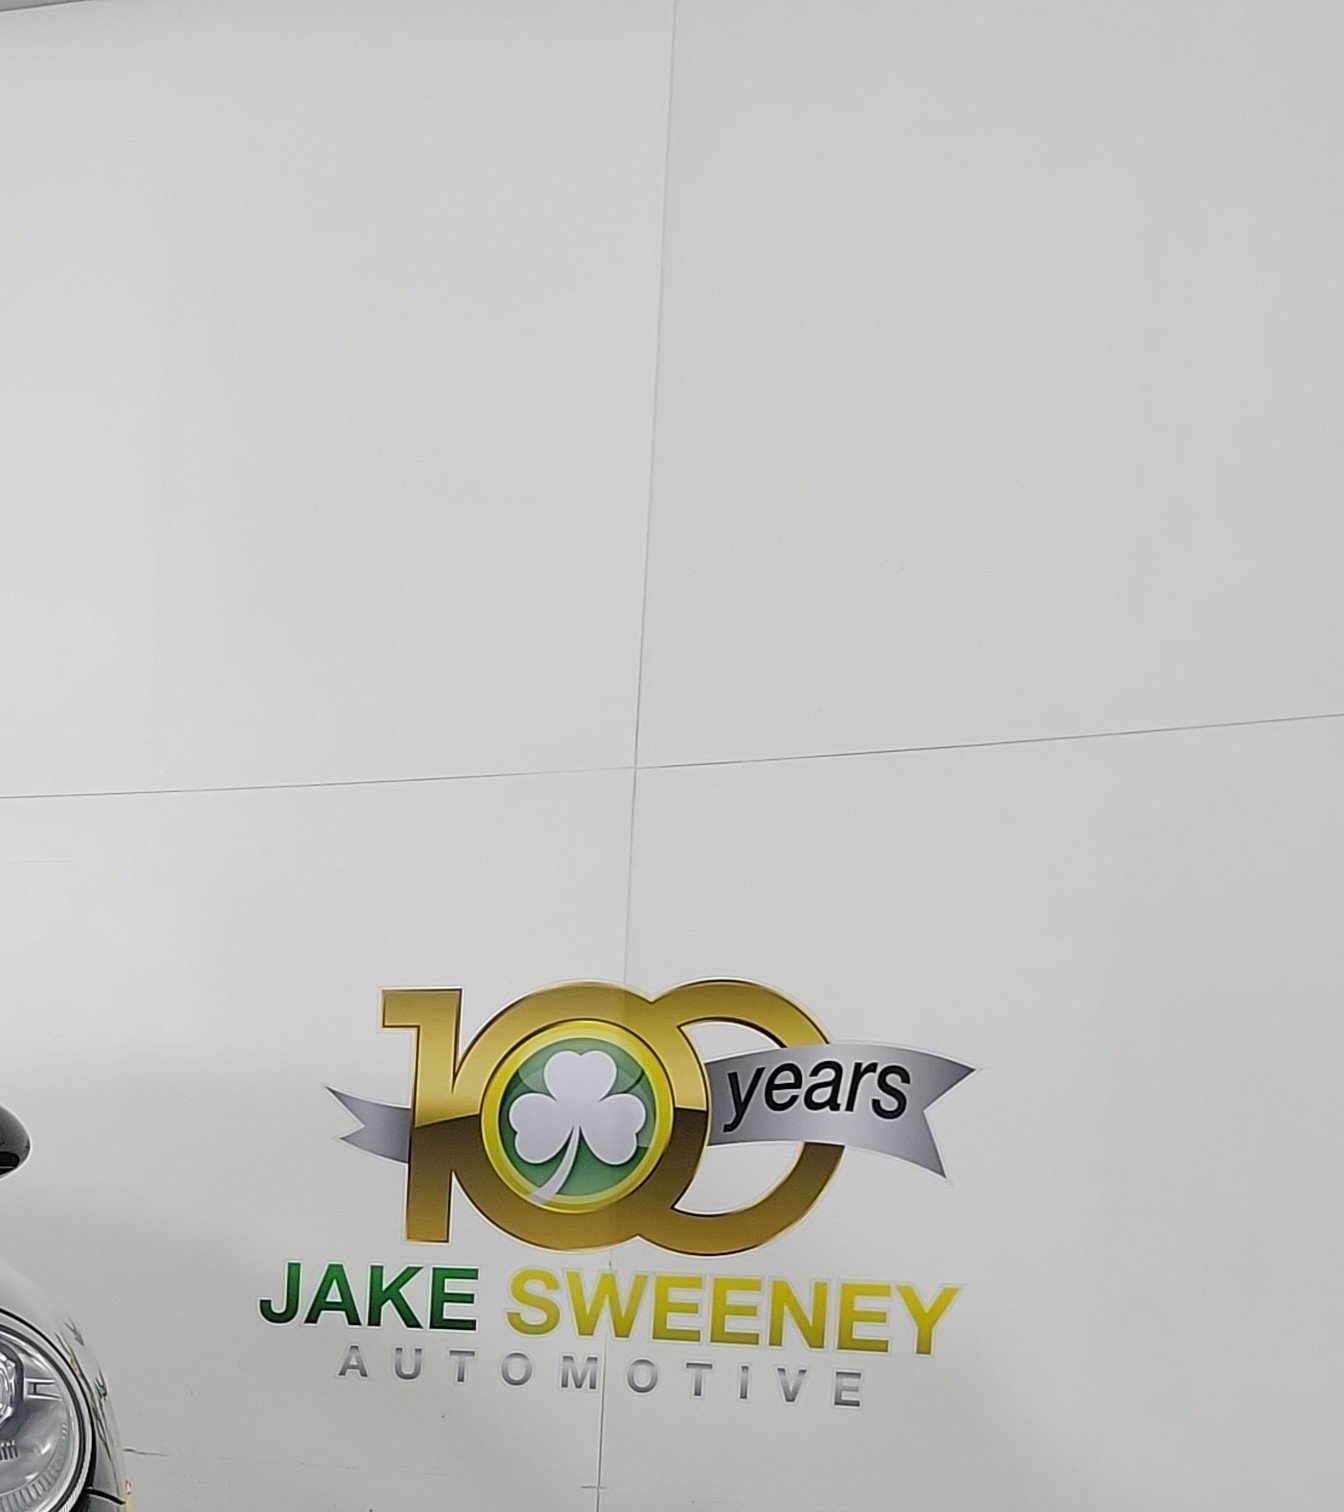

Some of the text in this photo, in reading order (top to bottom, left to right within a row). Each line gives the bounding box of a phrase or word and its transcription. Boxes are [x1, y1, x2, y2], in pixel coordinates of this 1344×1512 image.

[381, 979, 912, 1256] 100 years
[259, 1262, 961, 1355] JAKE SWEENEY
[338, 1345, 862, 1407] AUTOMOTIVE
